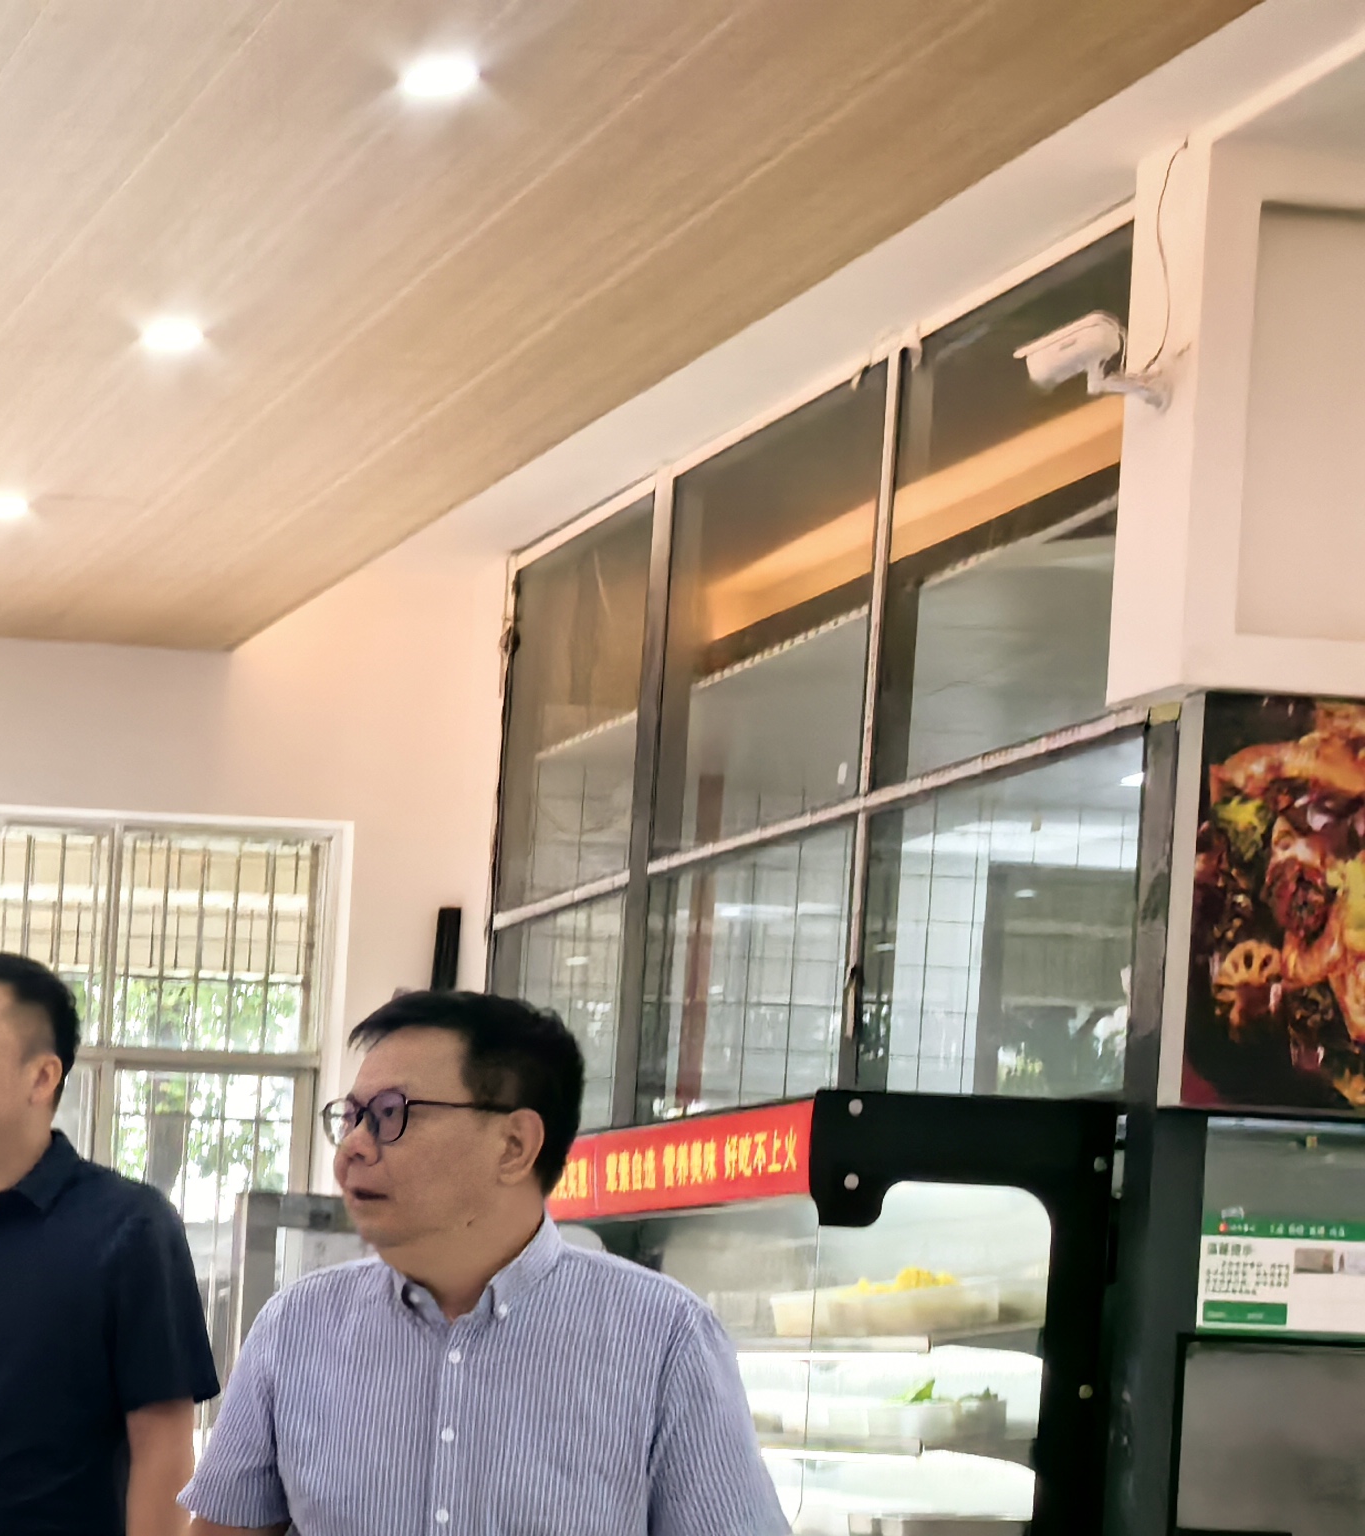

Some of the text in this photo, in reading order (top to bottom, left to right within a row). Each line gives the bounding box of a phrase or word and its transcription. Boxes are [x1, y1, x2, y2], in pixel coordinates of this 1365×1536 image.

[662, 1140, 717, 1189] 营养美味
[723, 1124, 798, 1181] 好吃不上火
